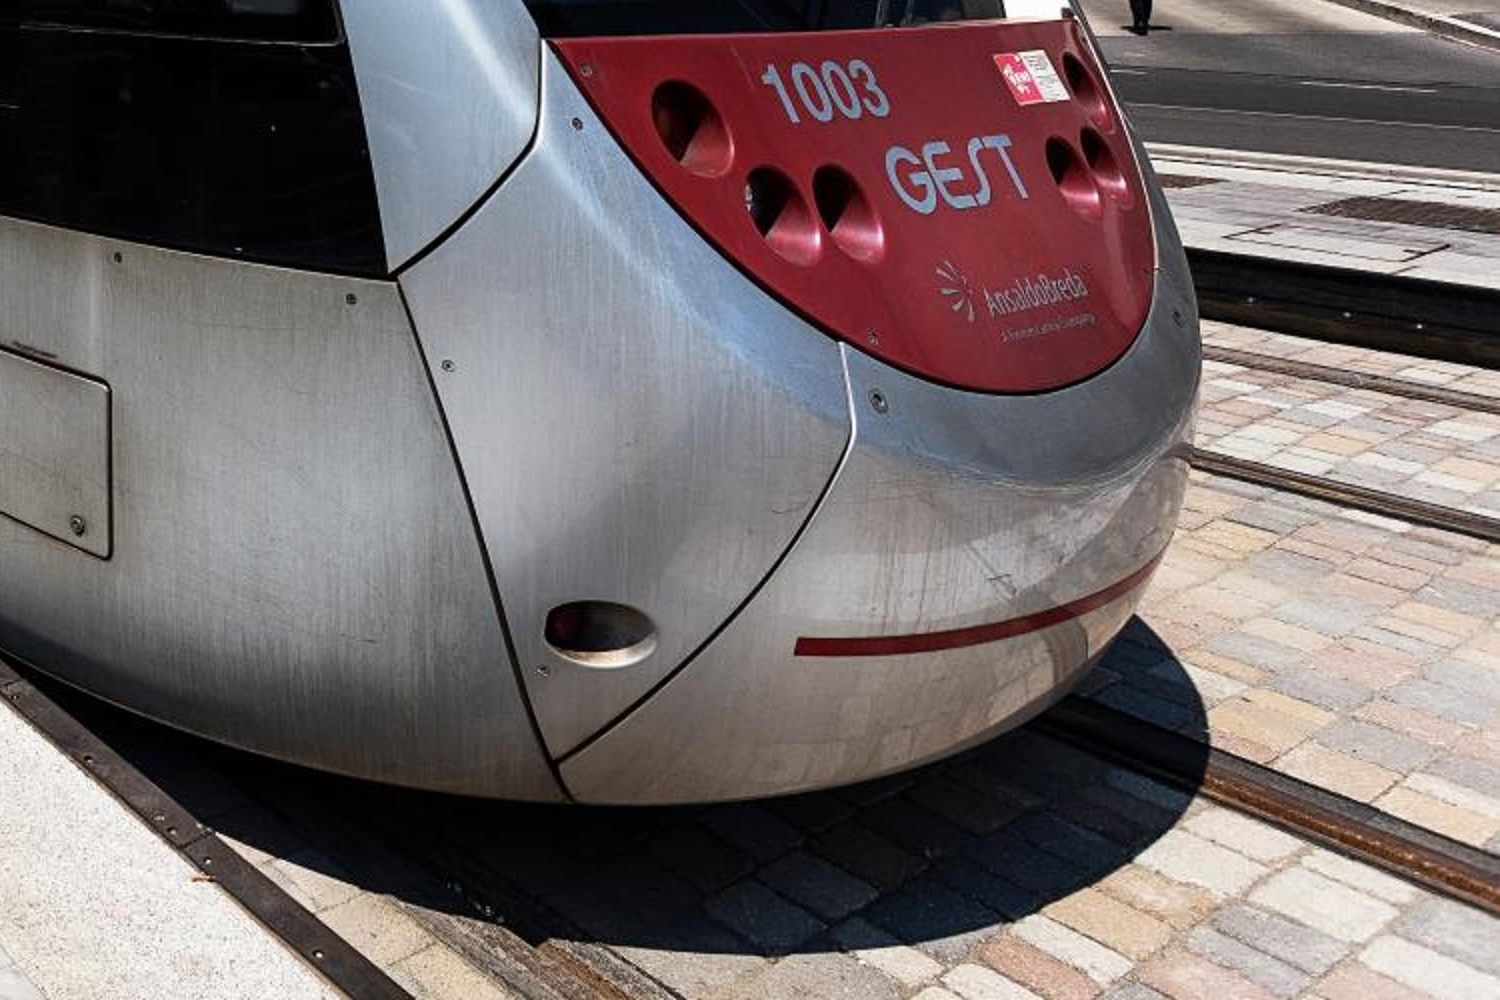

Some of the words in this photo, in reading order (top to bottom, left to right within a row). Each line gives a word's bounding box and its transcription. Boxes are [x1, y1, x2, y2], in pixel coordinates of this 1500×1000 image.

[762, 58, 890, 125] 1003
[885, 134, 1030, 216] GEST
[982, 267, 1089, 319] AnsaldoBreda
